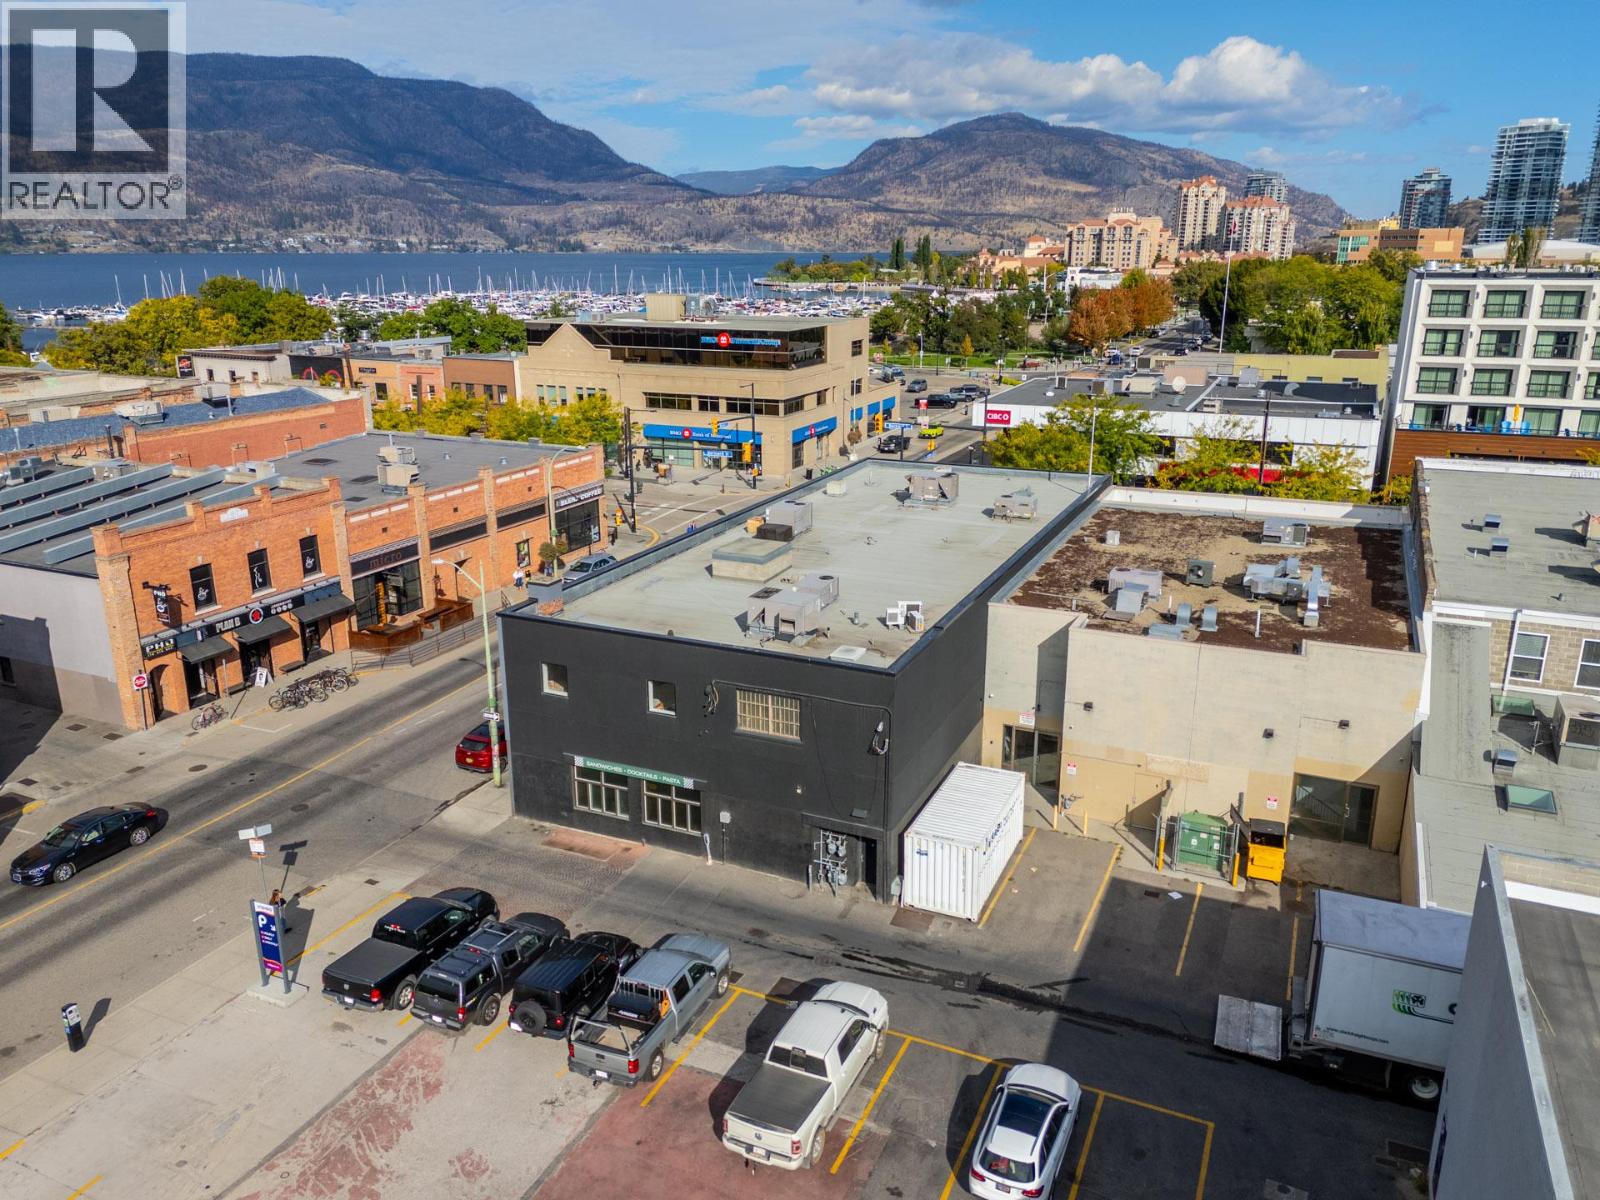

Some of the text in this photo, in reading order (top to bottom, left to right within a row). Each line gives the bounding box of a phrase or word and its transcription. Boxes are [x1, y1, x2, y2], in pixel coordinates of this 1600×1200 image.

[369, 550, 402, 570] micro
[586, 761, 681, 785] SANDWICHES COCKTAILS PASTA
